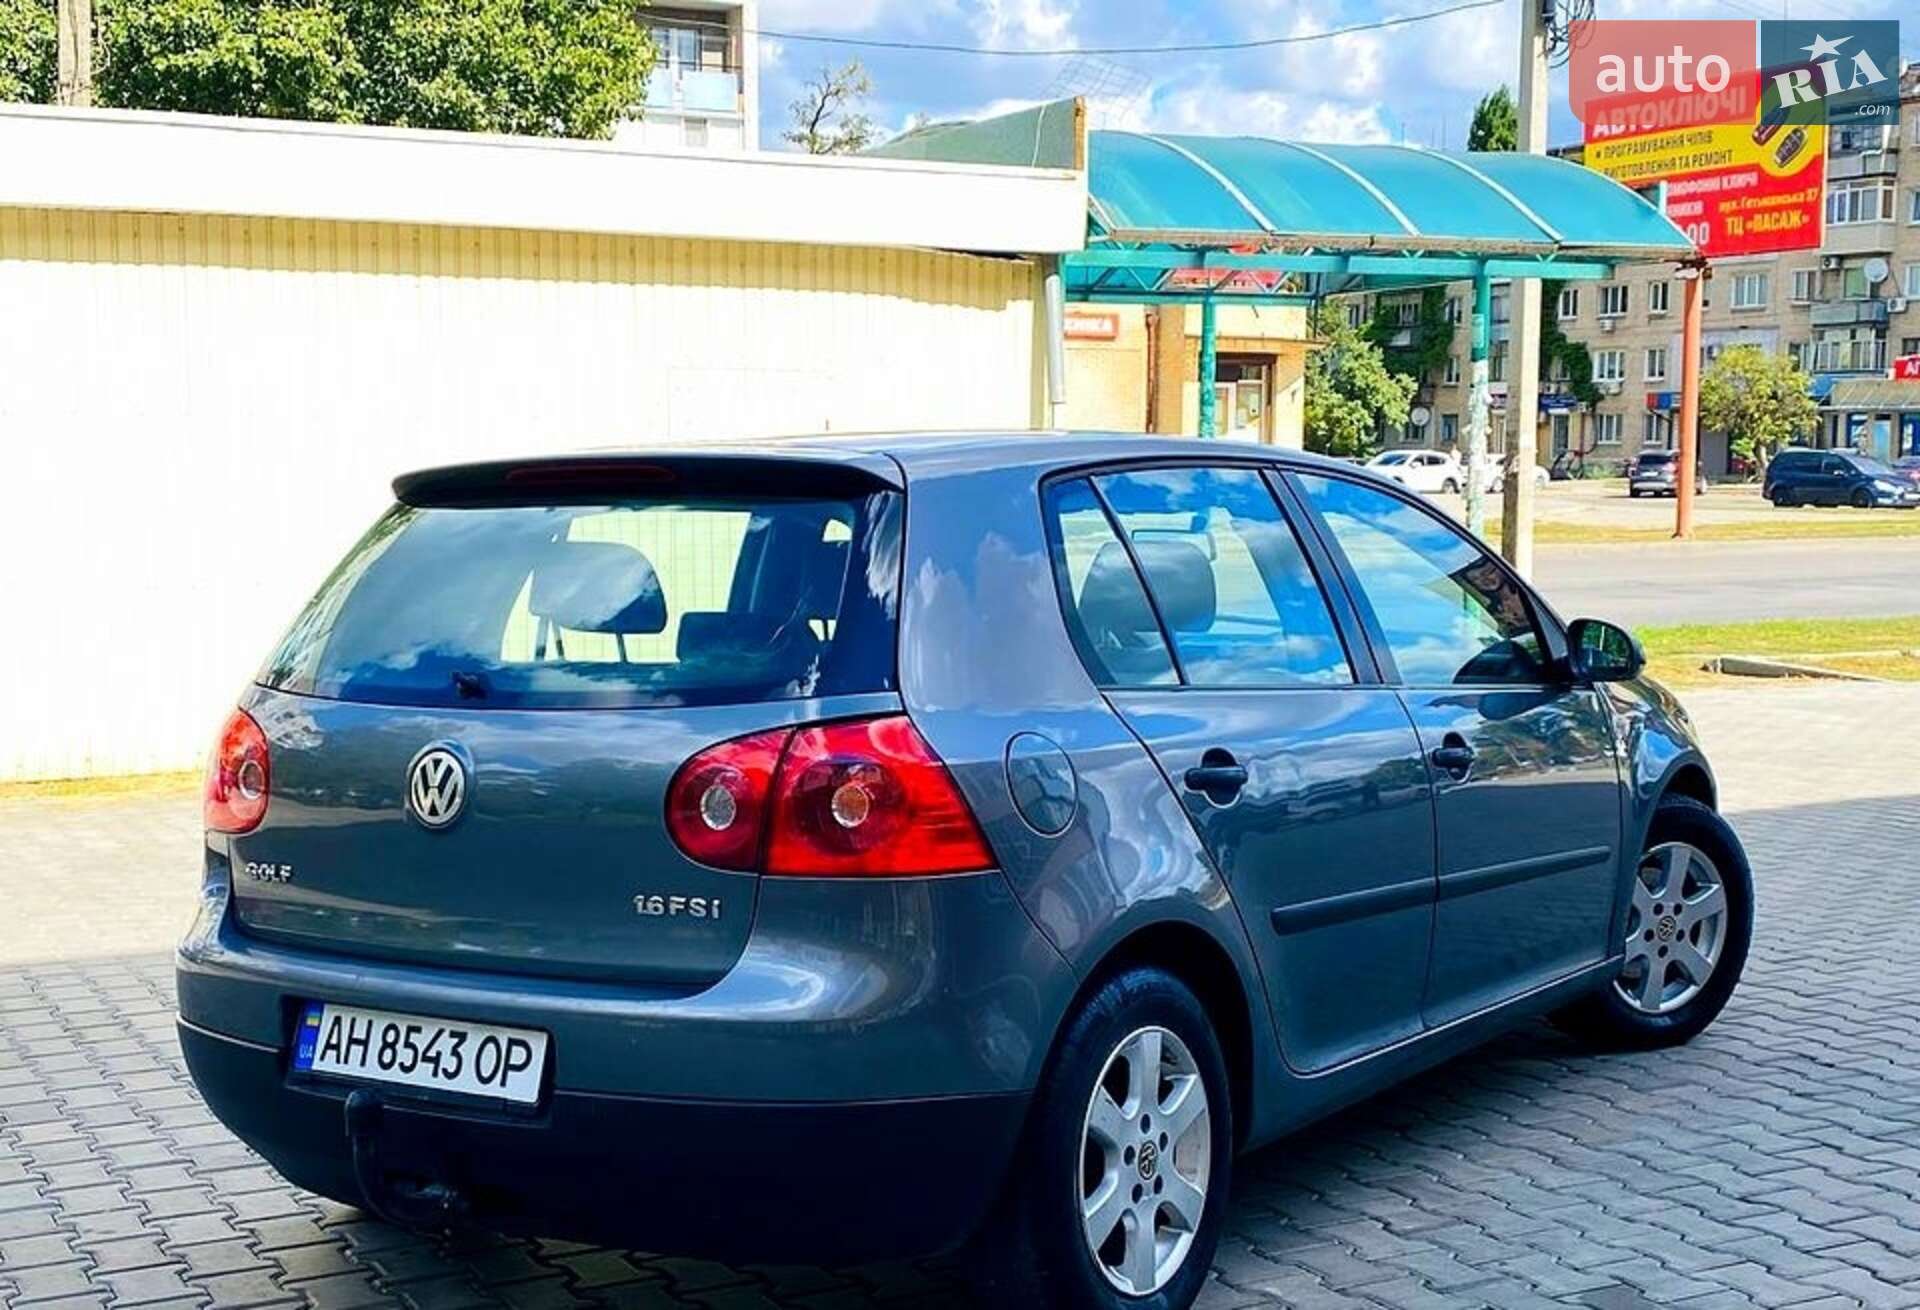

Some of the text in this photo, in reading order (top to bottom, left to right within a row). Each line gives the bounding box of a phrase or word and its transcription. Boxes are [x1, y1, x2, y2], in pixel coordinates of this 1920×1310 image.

[1691, 149, 1733, 167] РЕМОНТ
[245, 861, 292, 882] GOLF
[319, 1014, 532, 1088] AH 8543 OP
